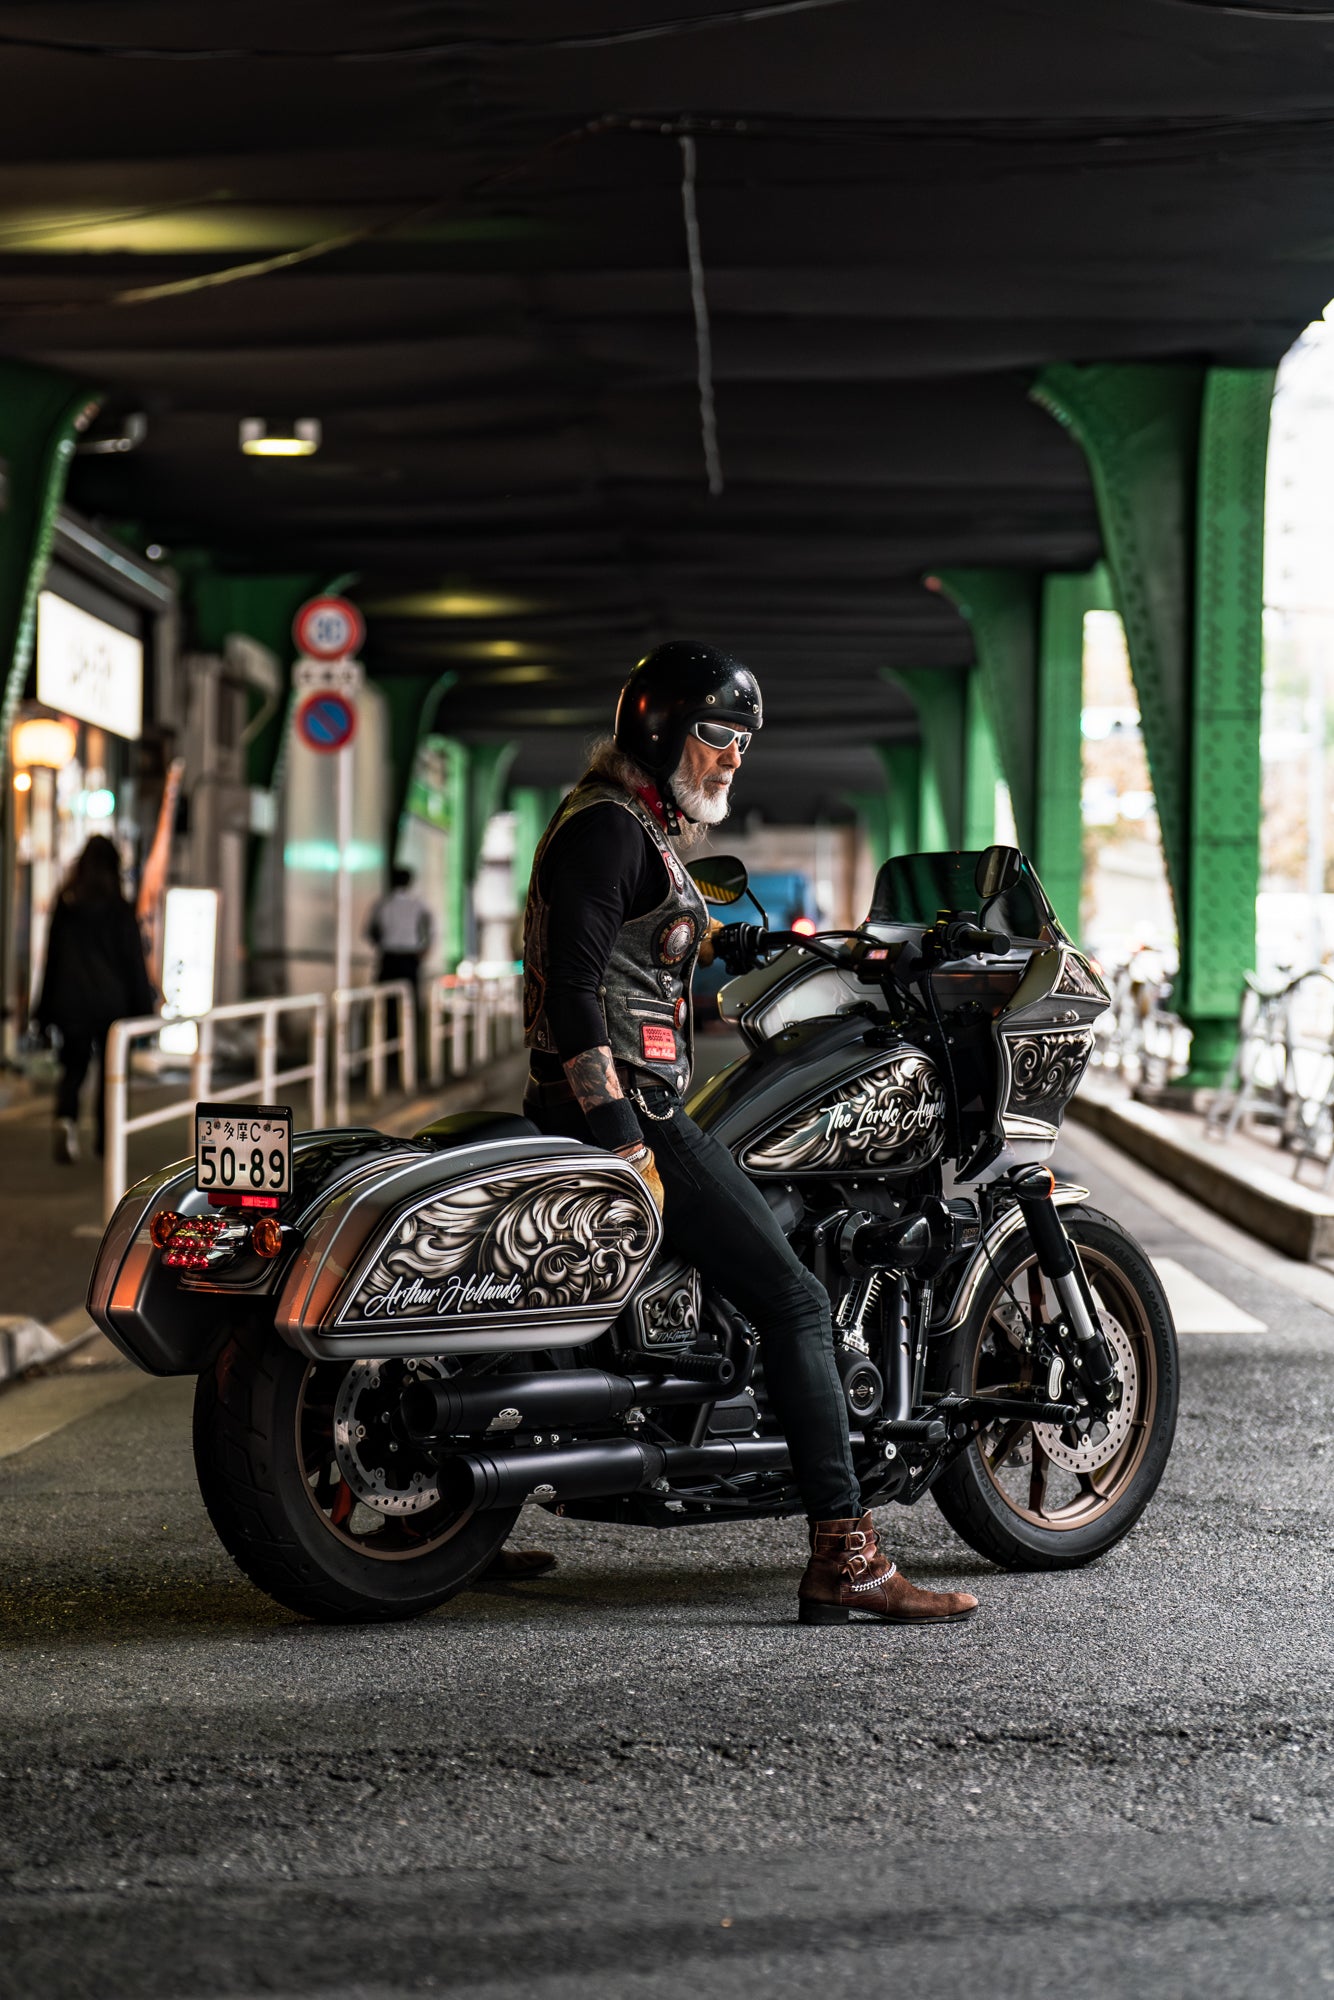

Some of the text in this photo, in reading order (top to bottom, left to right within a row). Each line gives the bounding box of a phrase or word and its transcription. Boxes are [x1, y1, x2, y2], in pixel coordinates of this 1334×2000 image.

[820, 1102, 853, 1140] The
[901, 1092, 946, 1130] Angels
[201, 1146, 285, 1188] 50-89
[364, 1272, 523, 1317] Arthur Hollands
